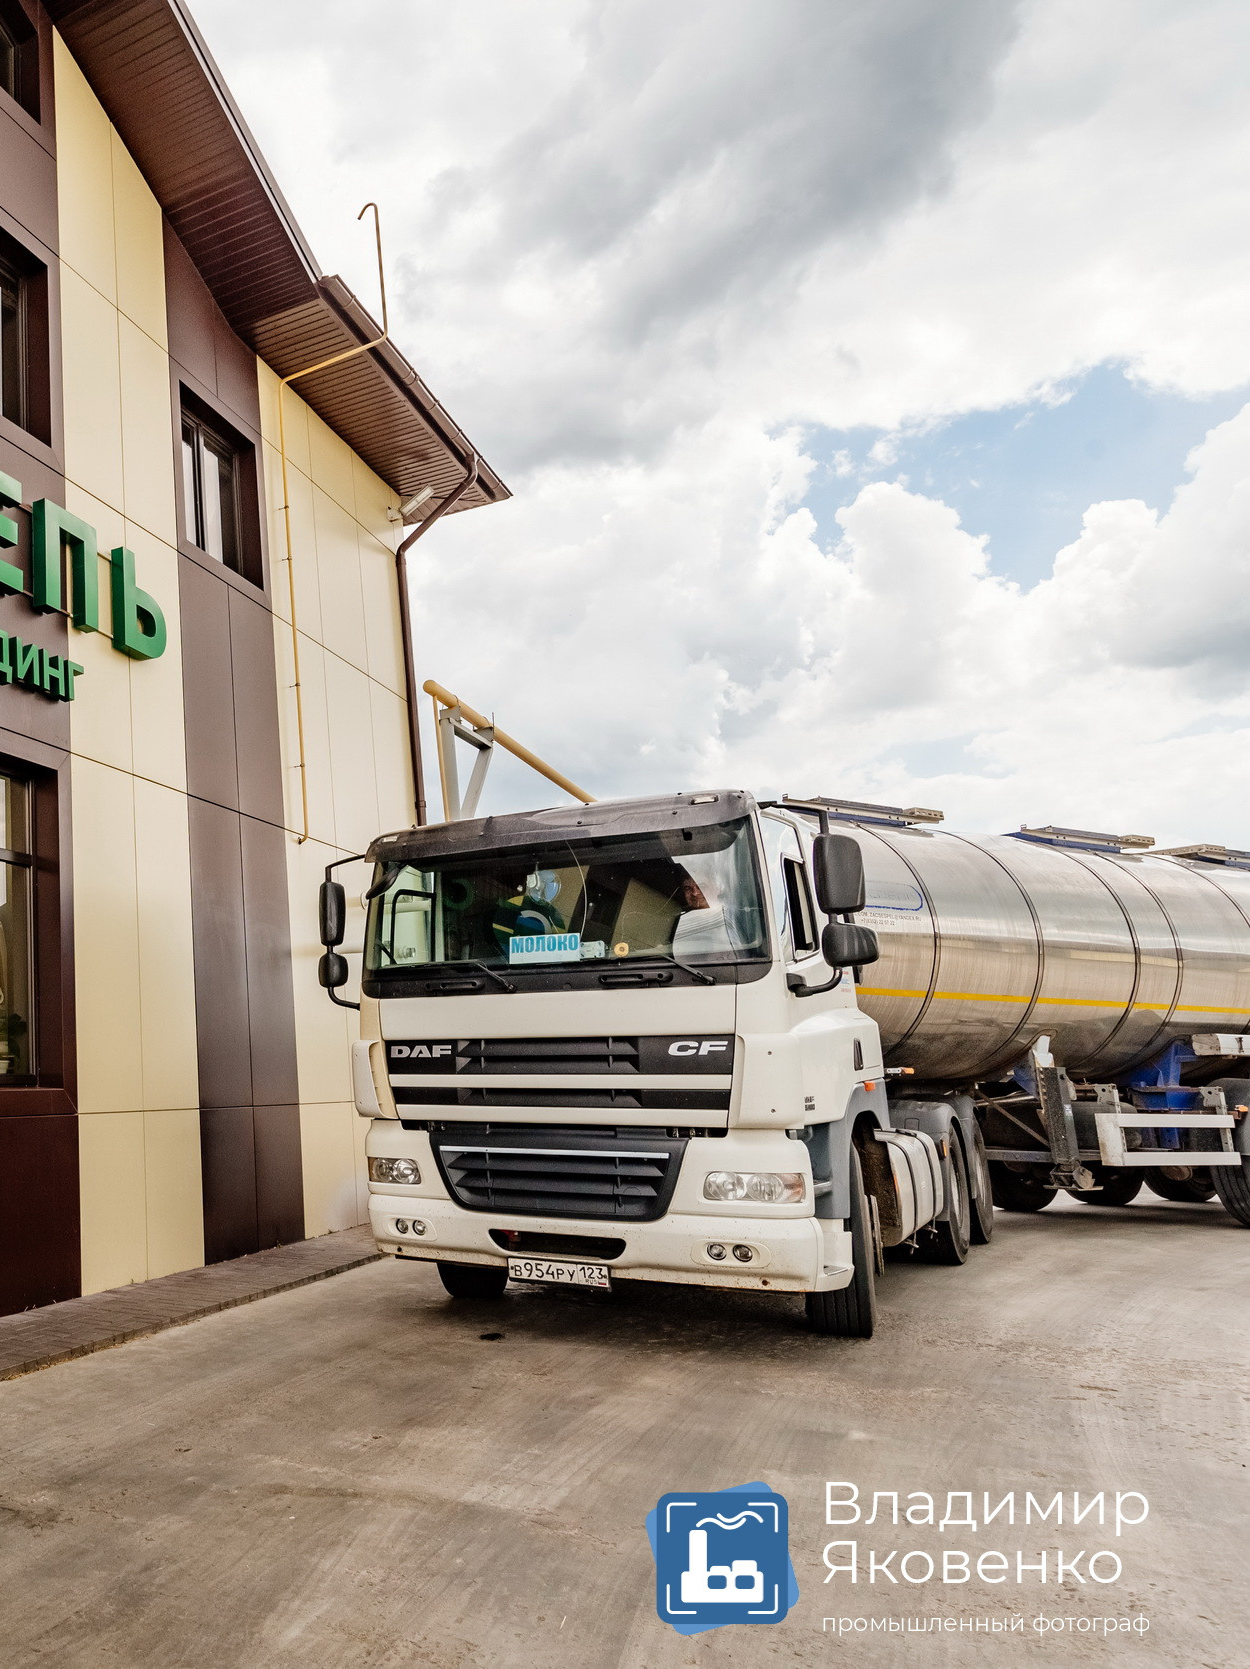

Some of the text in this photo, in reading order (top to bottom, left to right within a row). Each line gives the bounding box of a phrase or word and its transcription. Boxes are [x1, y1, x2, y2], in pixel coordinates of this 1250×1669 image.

[511, 934, 579, 954] МОЛОКО
[391, 1045, 452, 1058] DAF
[668, 1041, 728, 1056] CF
[513, 1262, 604, 1281] В954РУ 123
